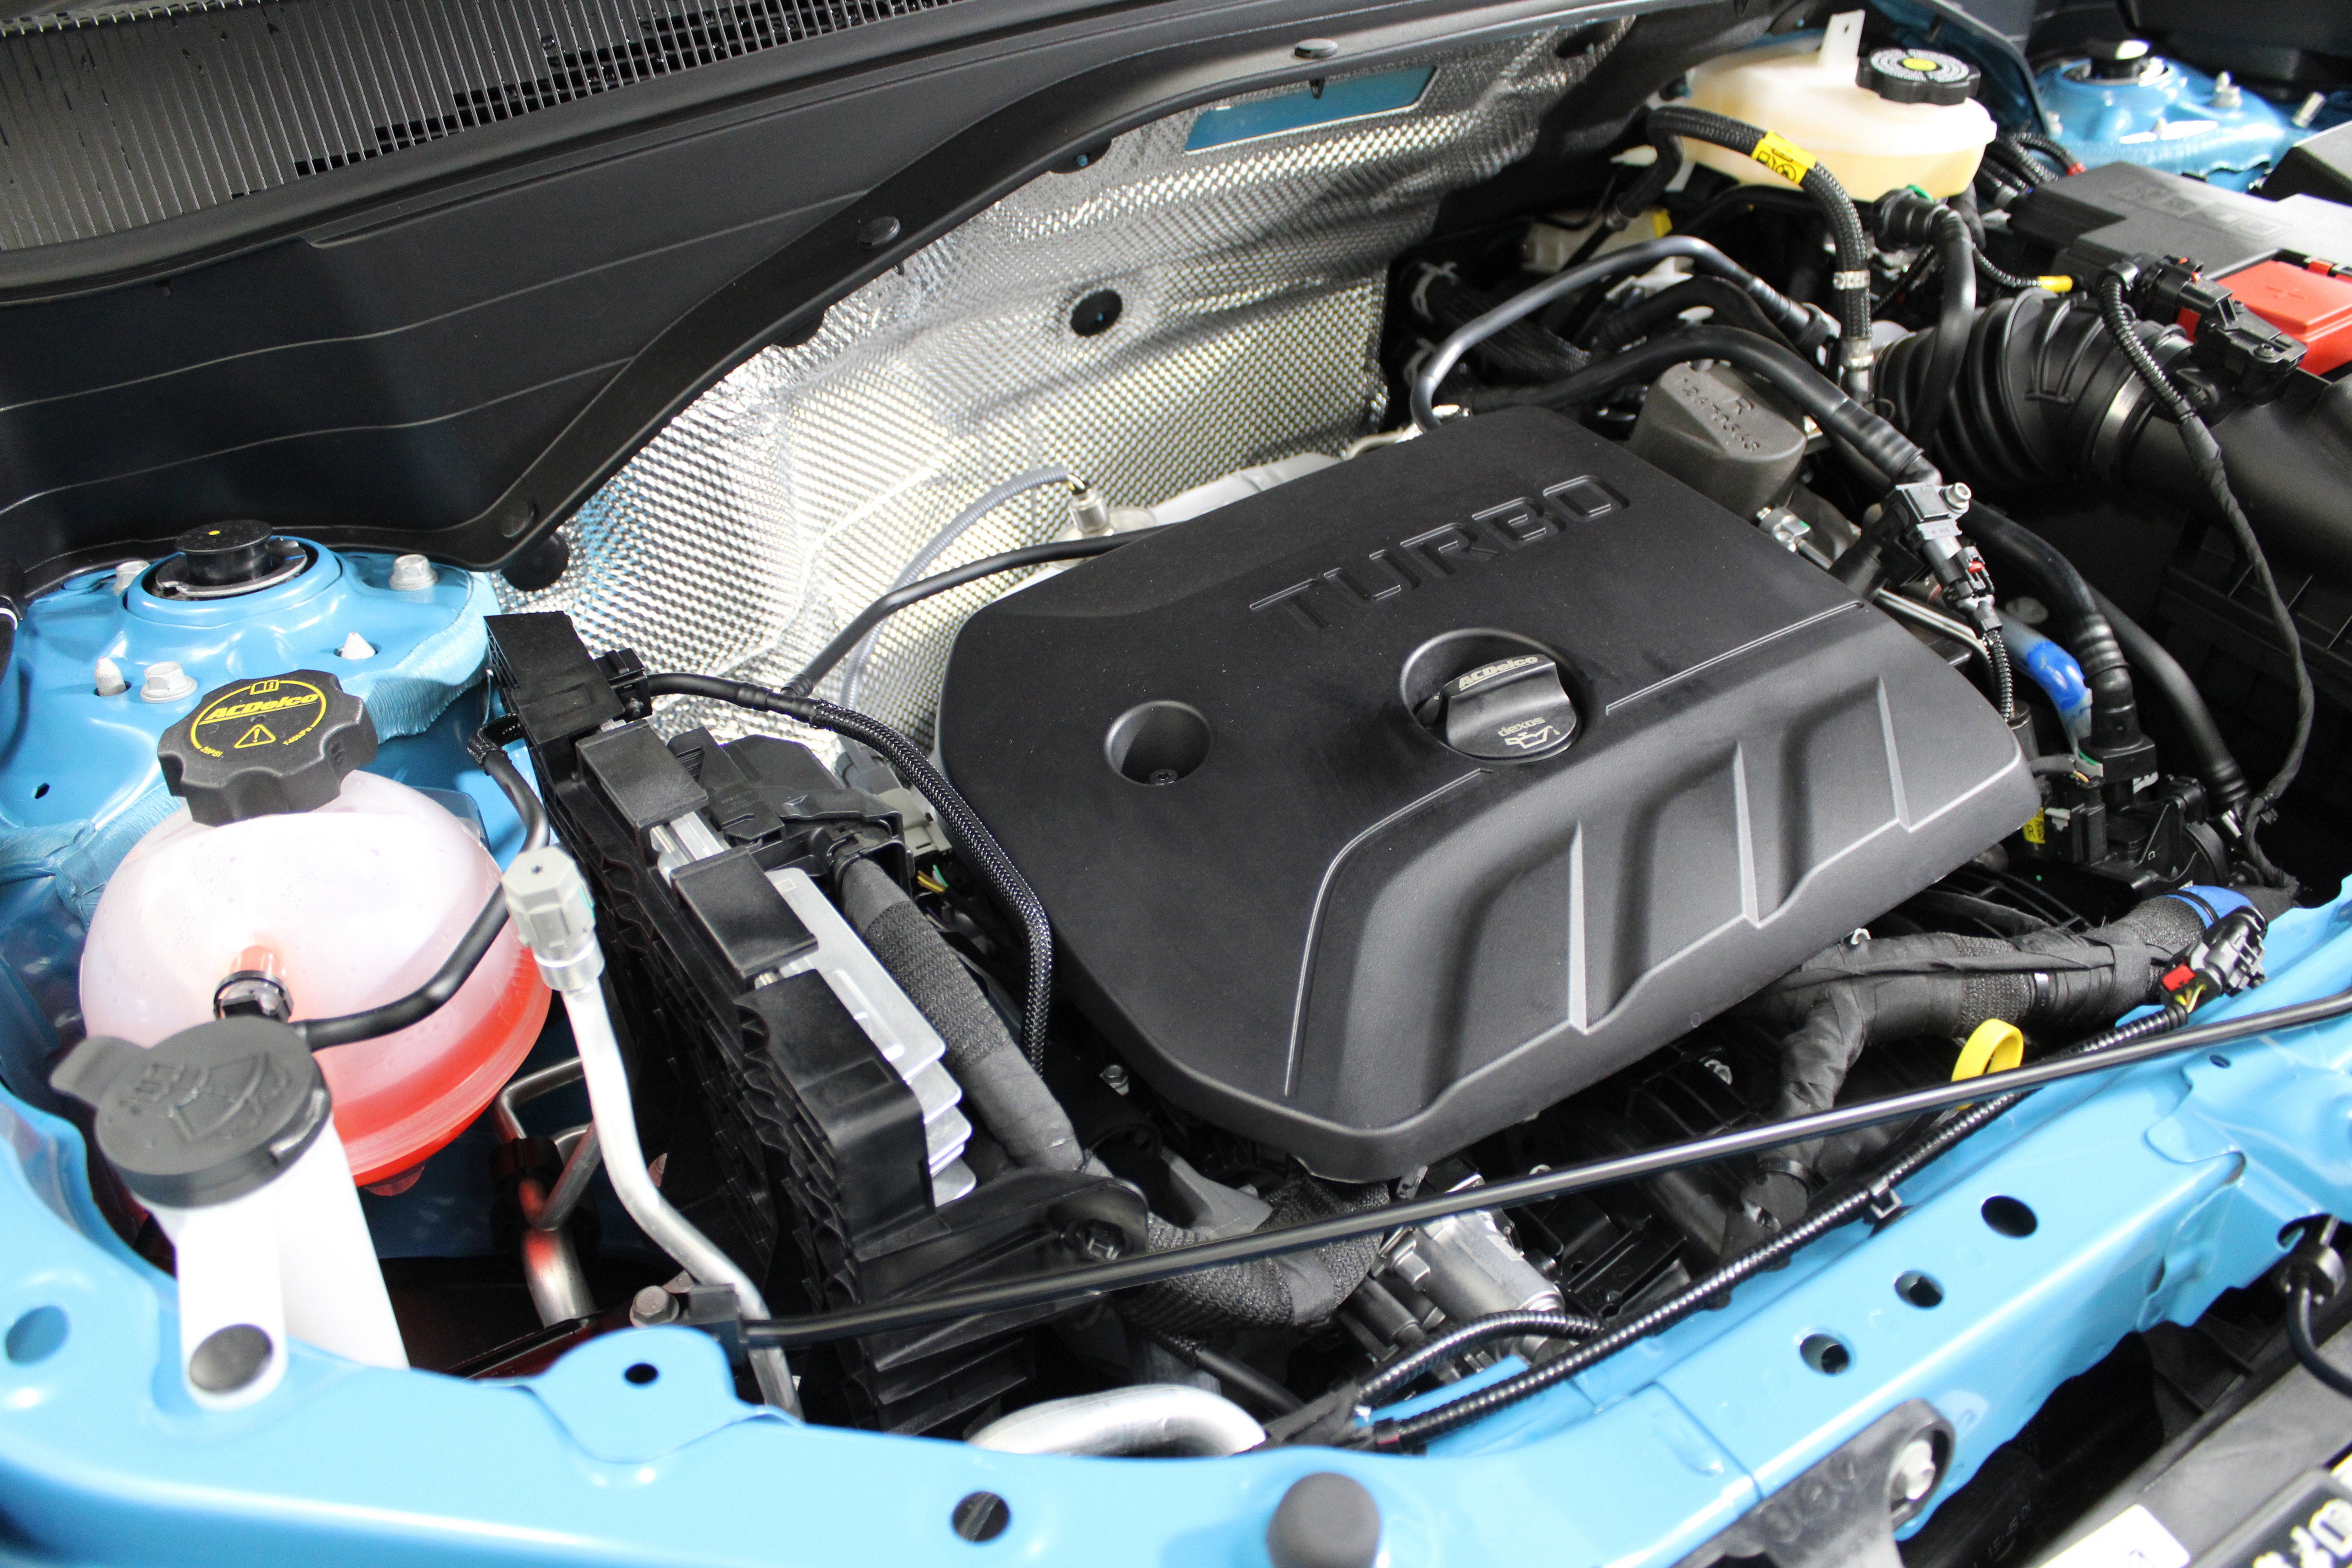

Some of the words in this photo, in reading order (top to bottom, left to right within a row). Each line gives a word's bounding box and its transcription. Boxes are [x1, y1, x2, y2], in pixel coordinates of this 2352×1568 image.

[1250, 474, 1630, 631] TURBO
[1458, 656, 1539, 689] ACDelco
[204, 693, 319, 721] ACDelco
[1498, 717, 1546, 737] dexos
[199, 746, 224, 757] 20PSI
